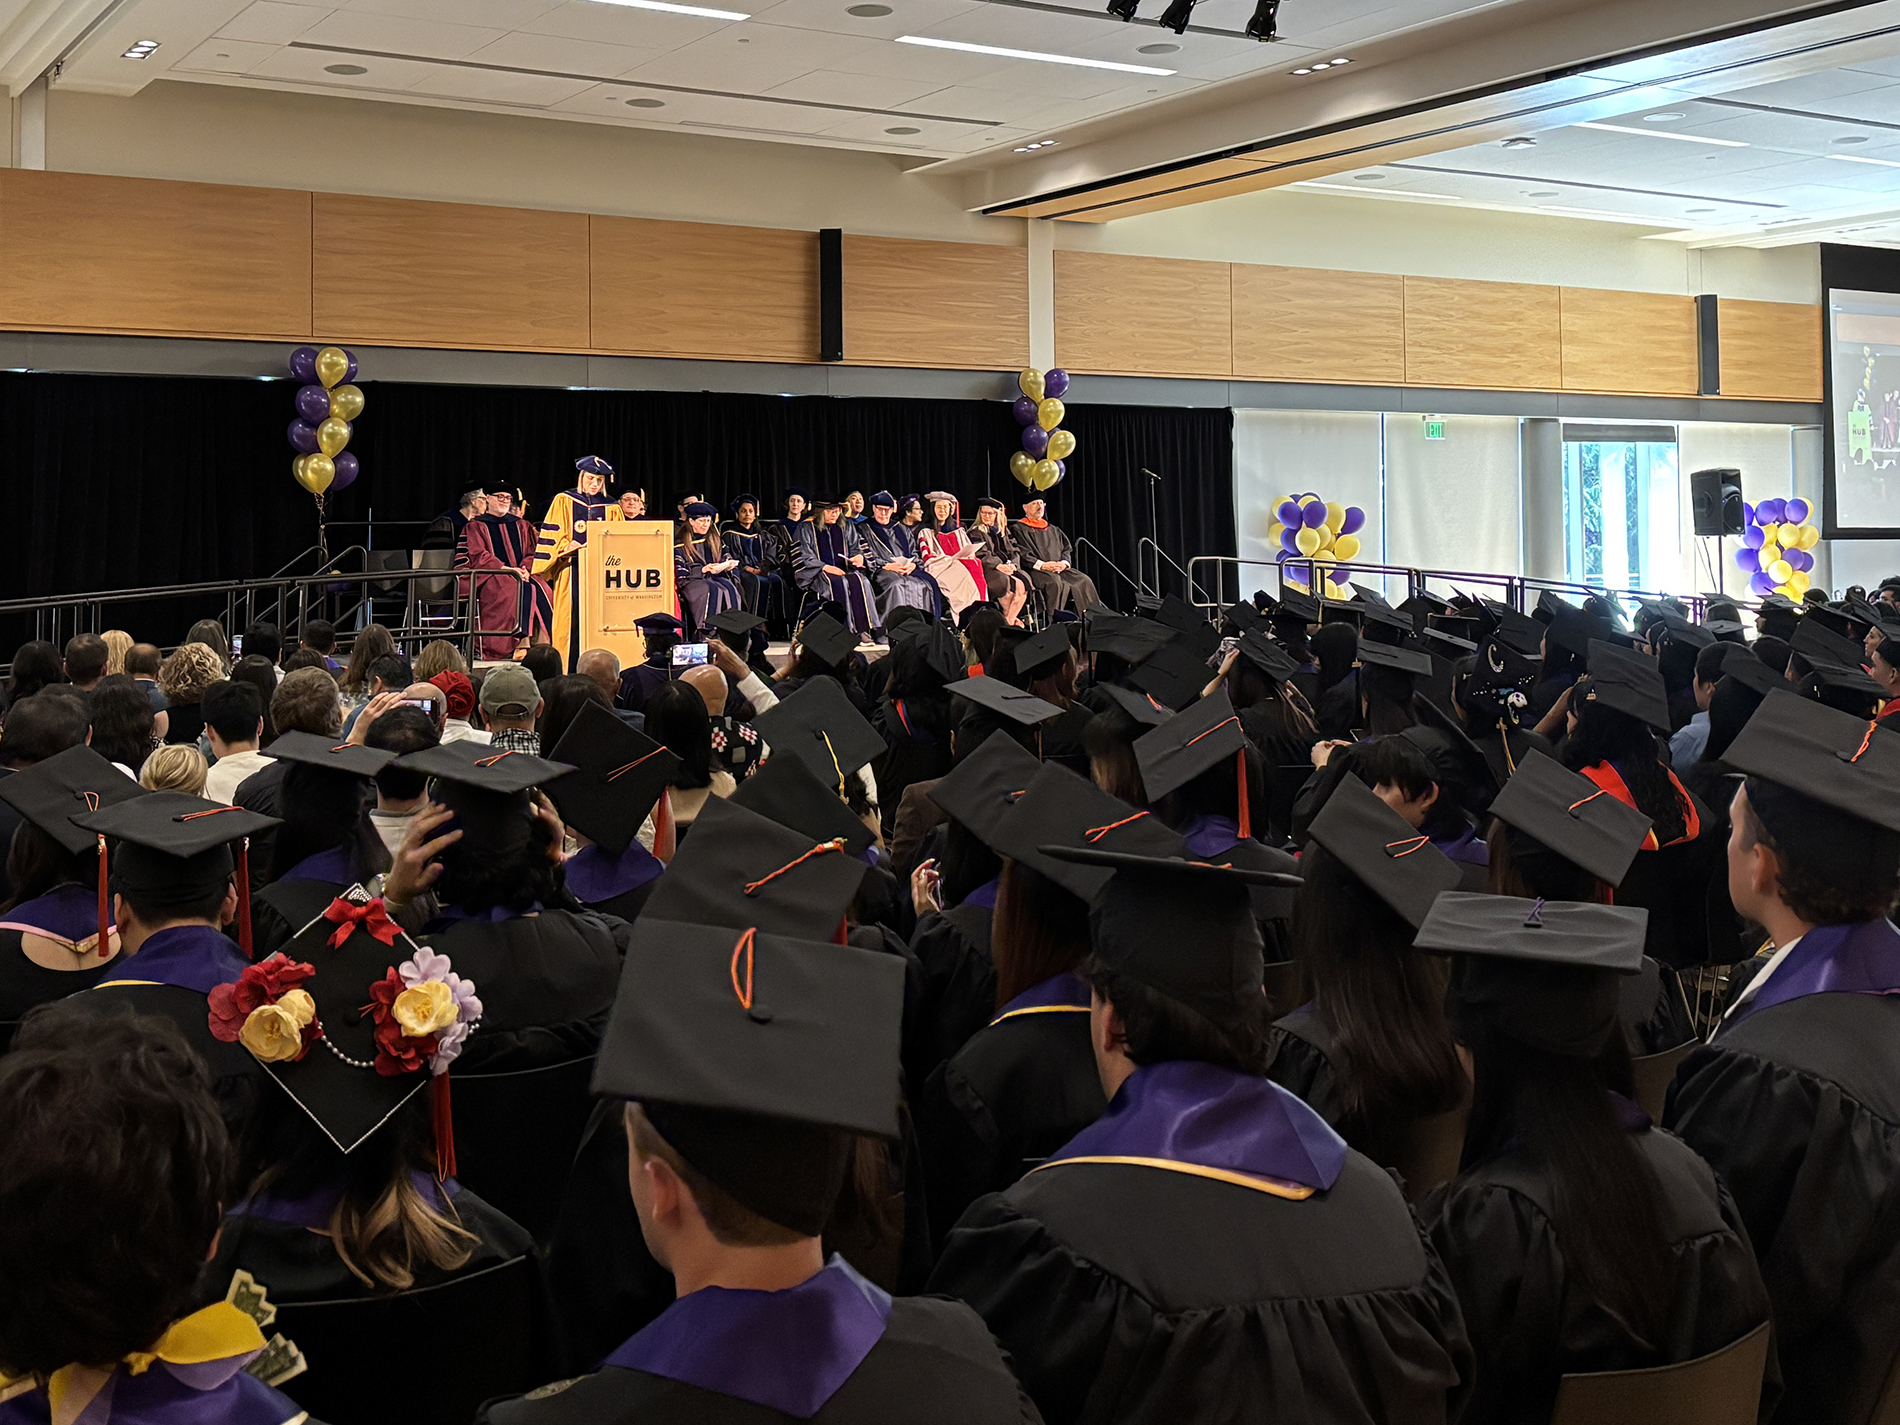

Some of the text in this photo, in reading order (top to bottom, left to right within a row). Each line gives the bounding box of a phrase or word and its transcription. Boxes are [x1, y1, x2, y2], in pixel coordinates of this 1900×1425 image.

[1852, 428, 1866, 436] HUB
[605, 554, 621, 566] the
[605, 569, 661, 588] HUB
